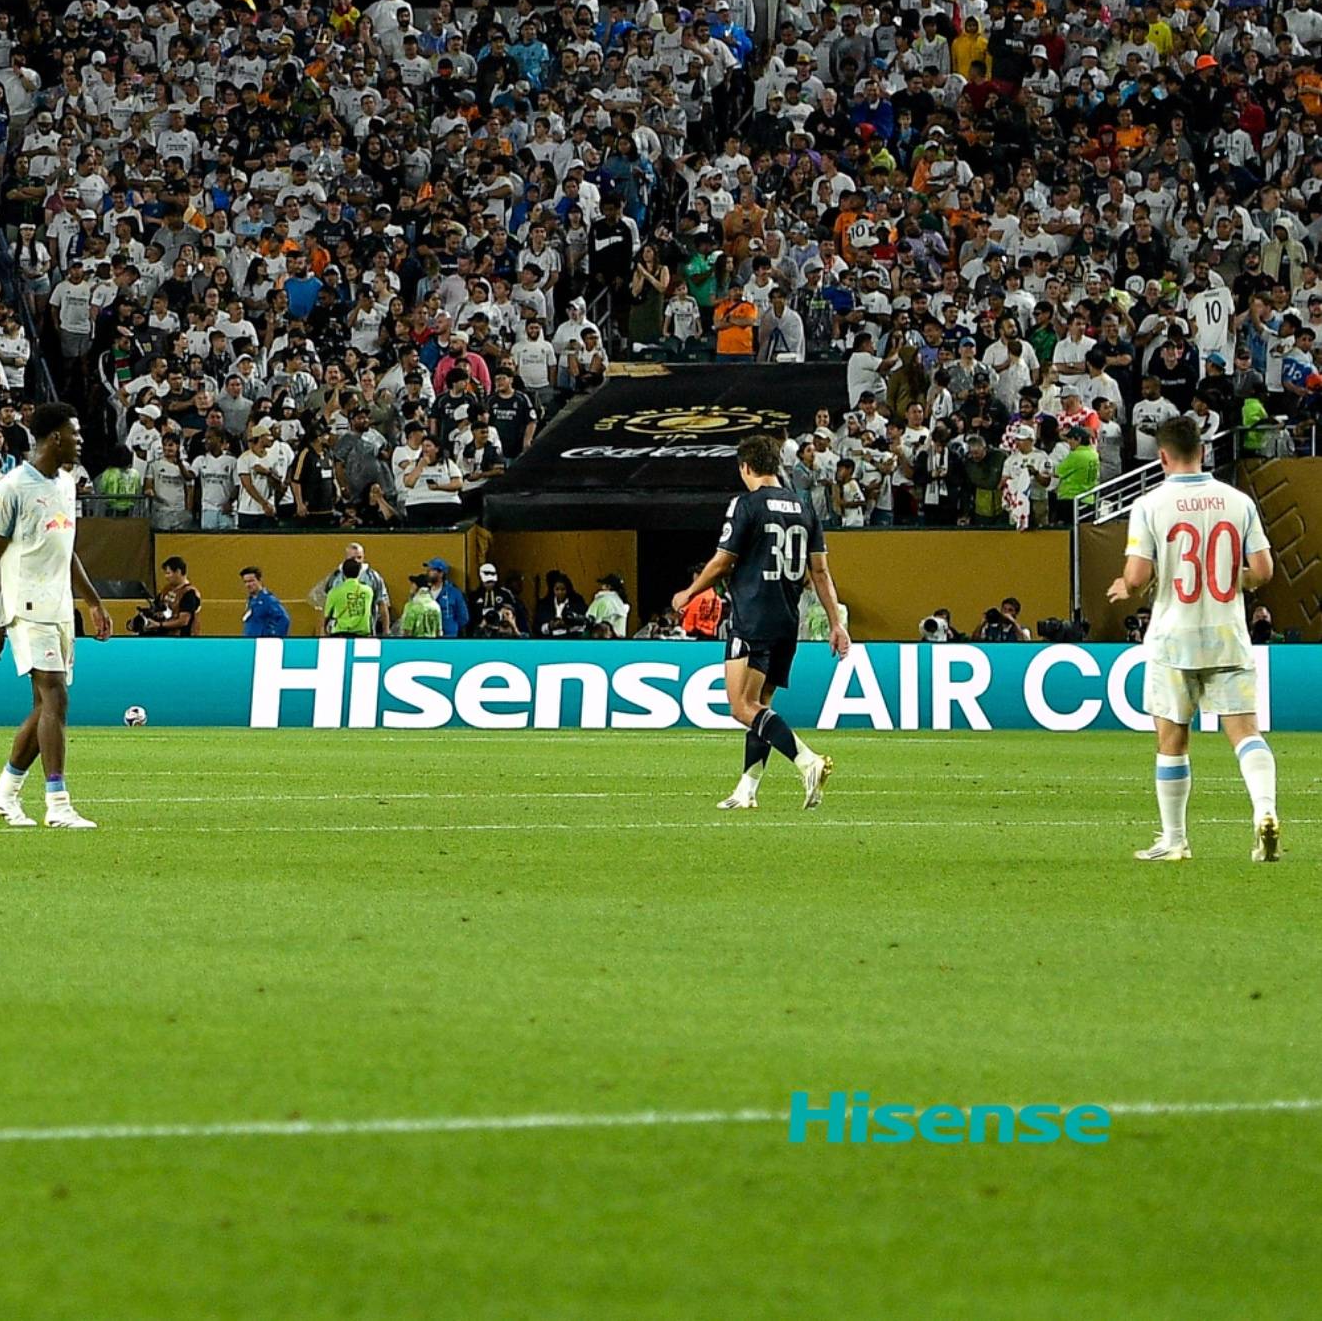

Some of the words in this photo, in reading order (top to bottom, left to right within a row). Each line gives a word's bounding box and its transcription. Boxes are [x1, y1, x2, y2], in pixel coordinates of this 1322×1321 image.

[1204, 300, 1224, 325] 10
[1176, 497, 1225, 512] GLOUKH
[762, 523, 809, 582] 30
[1166, 521, 1241, 604] 30
[249, 638, 745, 731] Hisense
[817, 643, 993, 731] AIR
